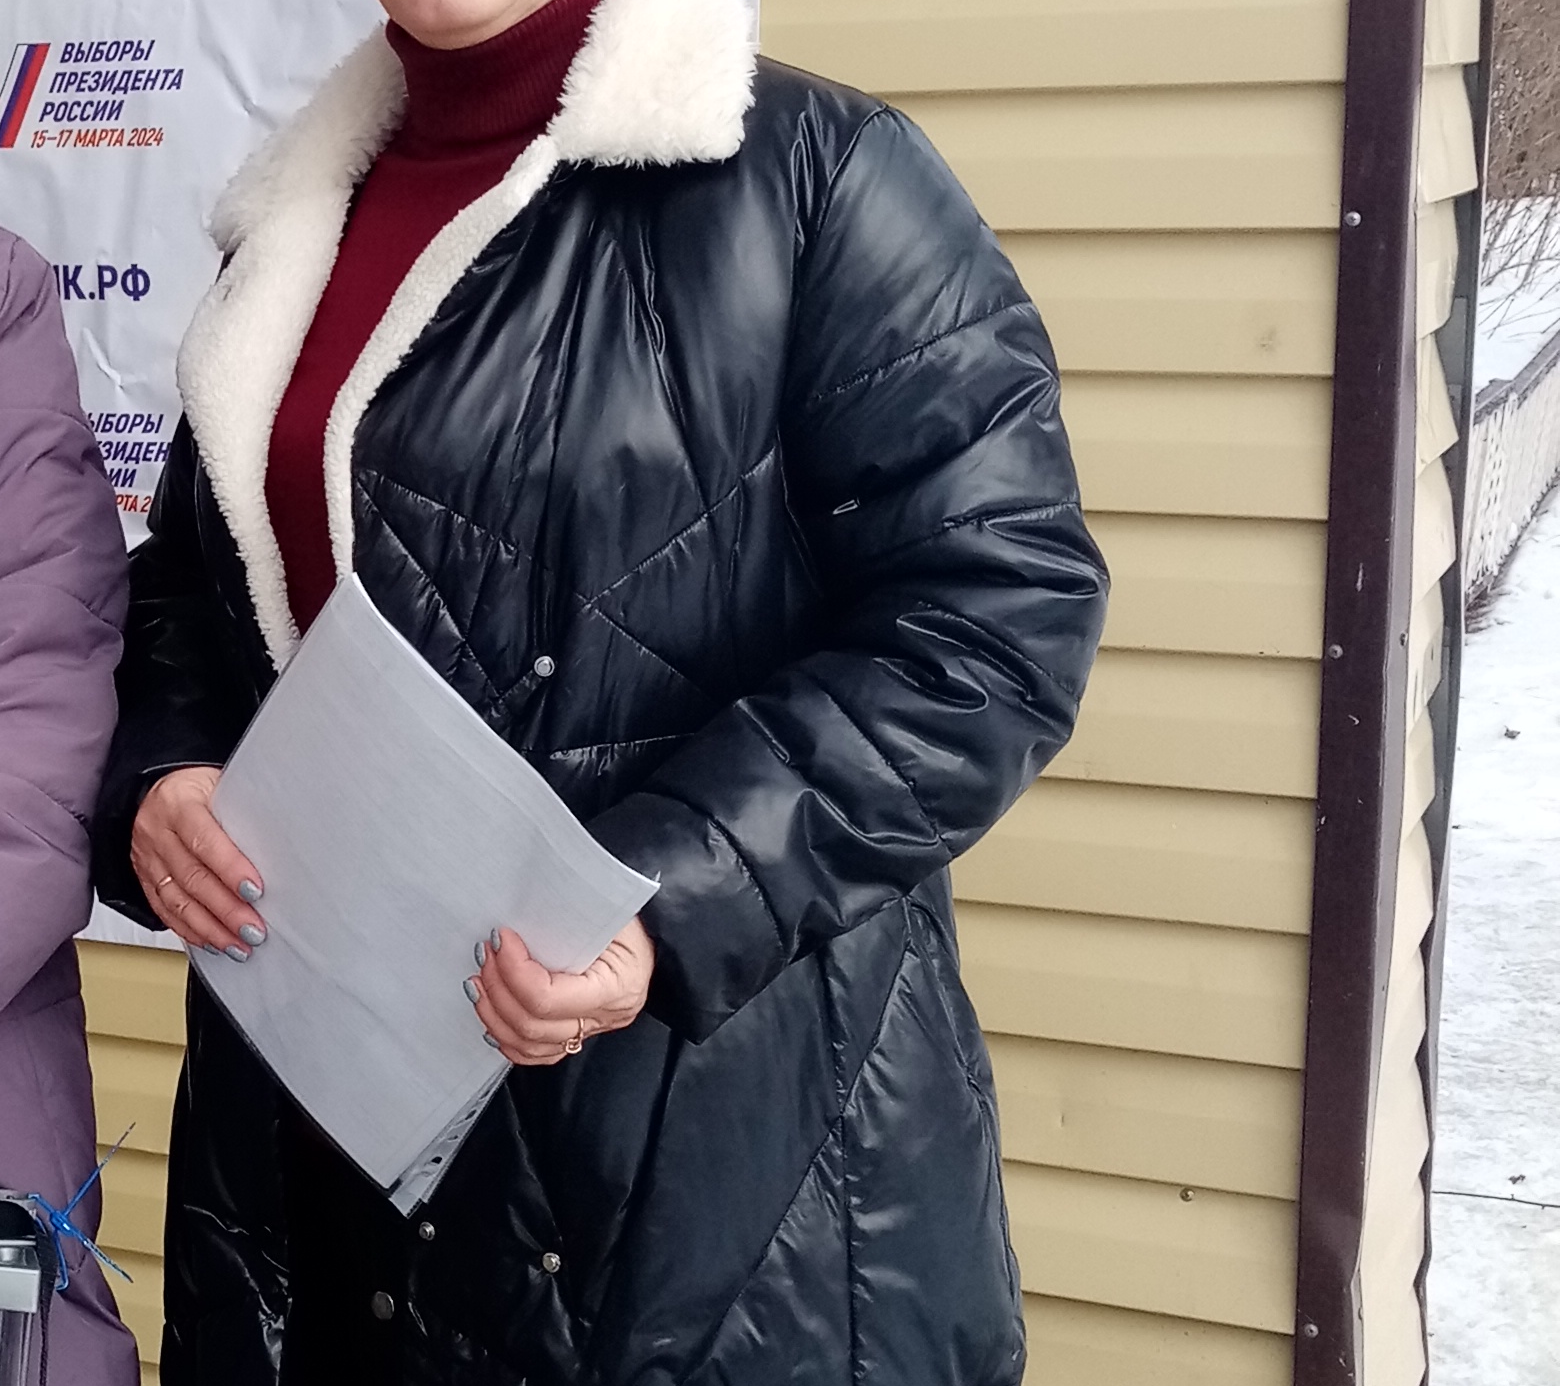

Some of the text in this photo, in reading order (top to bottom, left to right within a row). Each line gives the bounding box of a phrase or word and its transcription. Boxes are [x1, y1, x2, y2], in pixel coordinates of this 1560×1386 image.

[60, 40, 155, 63] ВЫБОРЫ
[49, 69, 183, 95] ПРЕЗИДЕНТА
[39, 100, 124, 122] РОССИИ
[74, 129, 124, 147] МАРТА
[127, 128, 163, 146] 2024
[88, 413, 164, 434] ЫБОРЫ
